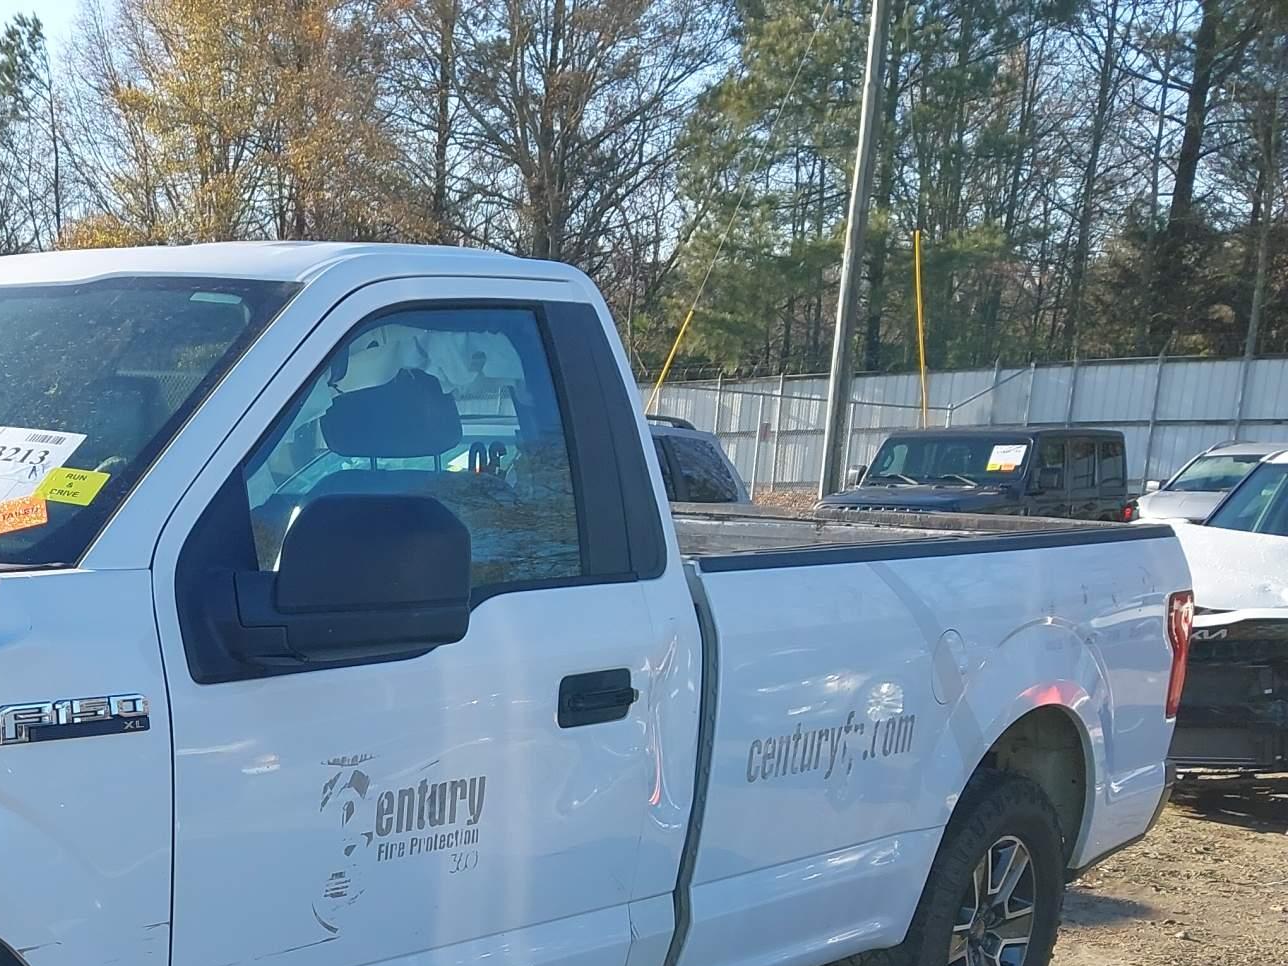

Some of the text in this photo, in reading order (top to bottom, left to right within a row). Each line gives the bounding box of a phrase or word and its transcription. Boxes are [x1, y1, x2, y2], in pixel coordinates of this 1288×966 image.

[65, 472, 88, 481] RUN
[123, 719, 145, 730] XL
[377, 828, 479, 861] Fire Protection
